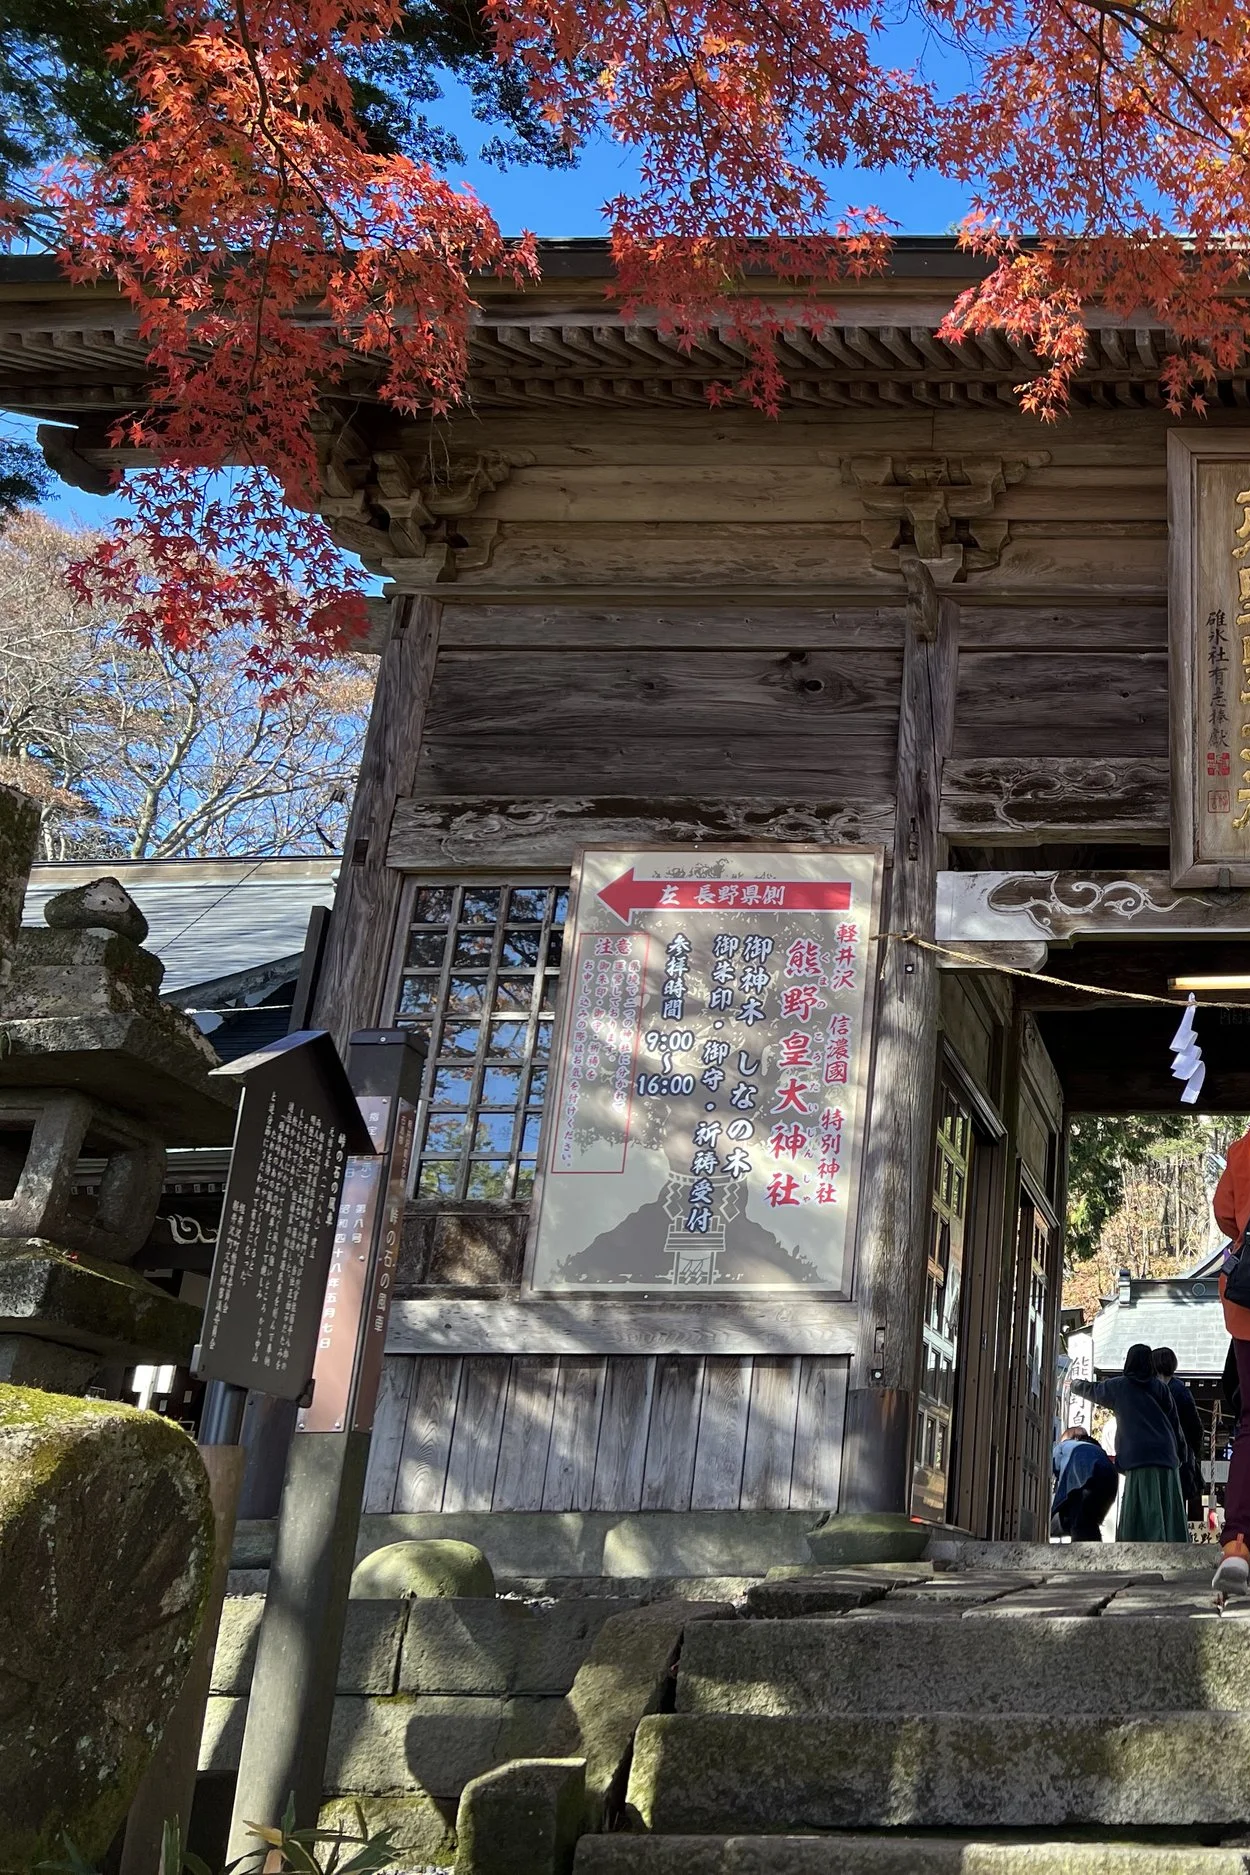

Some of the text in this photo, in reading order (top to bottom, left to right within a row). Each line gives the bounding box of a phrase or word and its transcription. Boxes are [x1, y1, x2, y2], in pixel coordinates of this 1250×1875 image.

[659, 884, 786, 906] 左 長野県側
[595, 938, 632, 955] 注意
[662, 934, 691, 1021] 参拝時間
[605, 959, 627, 1064] 運営しております。
[645, 1031, 694, 1051] 9:00
[637, 1073, 695, 1096] 16:00
[722, 935, 773, 1179] 御神木 しなの木
[766, 940, 822, 1208] 熊野皇大神社
[815, 922, 859, 1204] 軽井沢 信濃國 特別神社
[325, 1133, 347, 1226] 峠の石の風車
[352, 1204, 366, 1244] 第八号
[320, 1204, 351, 1349] 昭和四十八年五月七日
